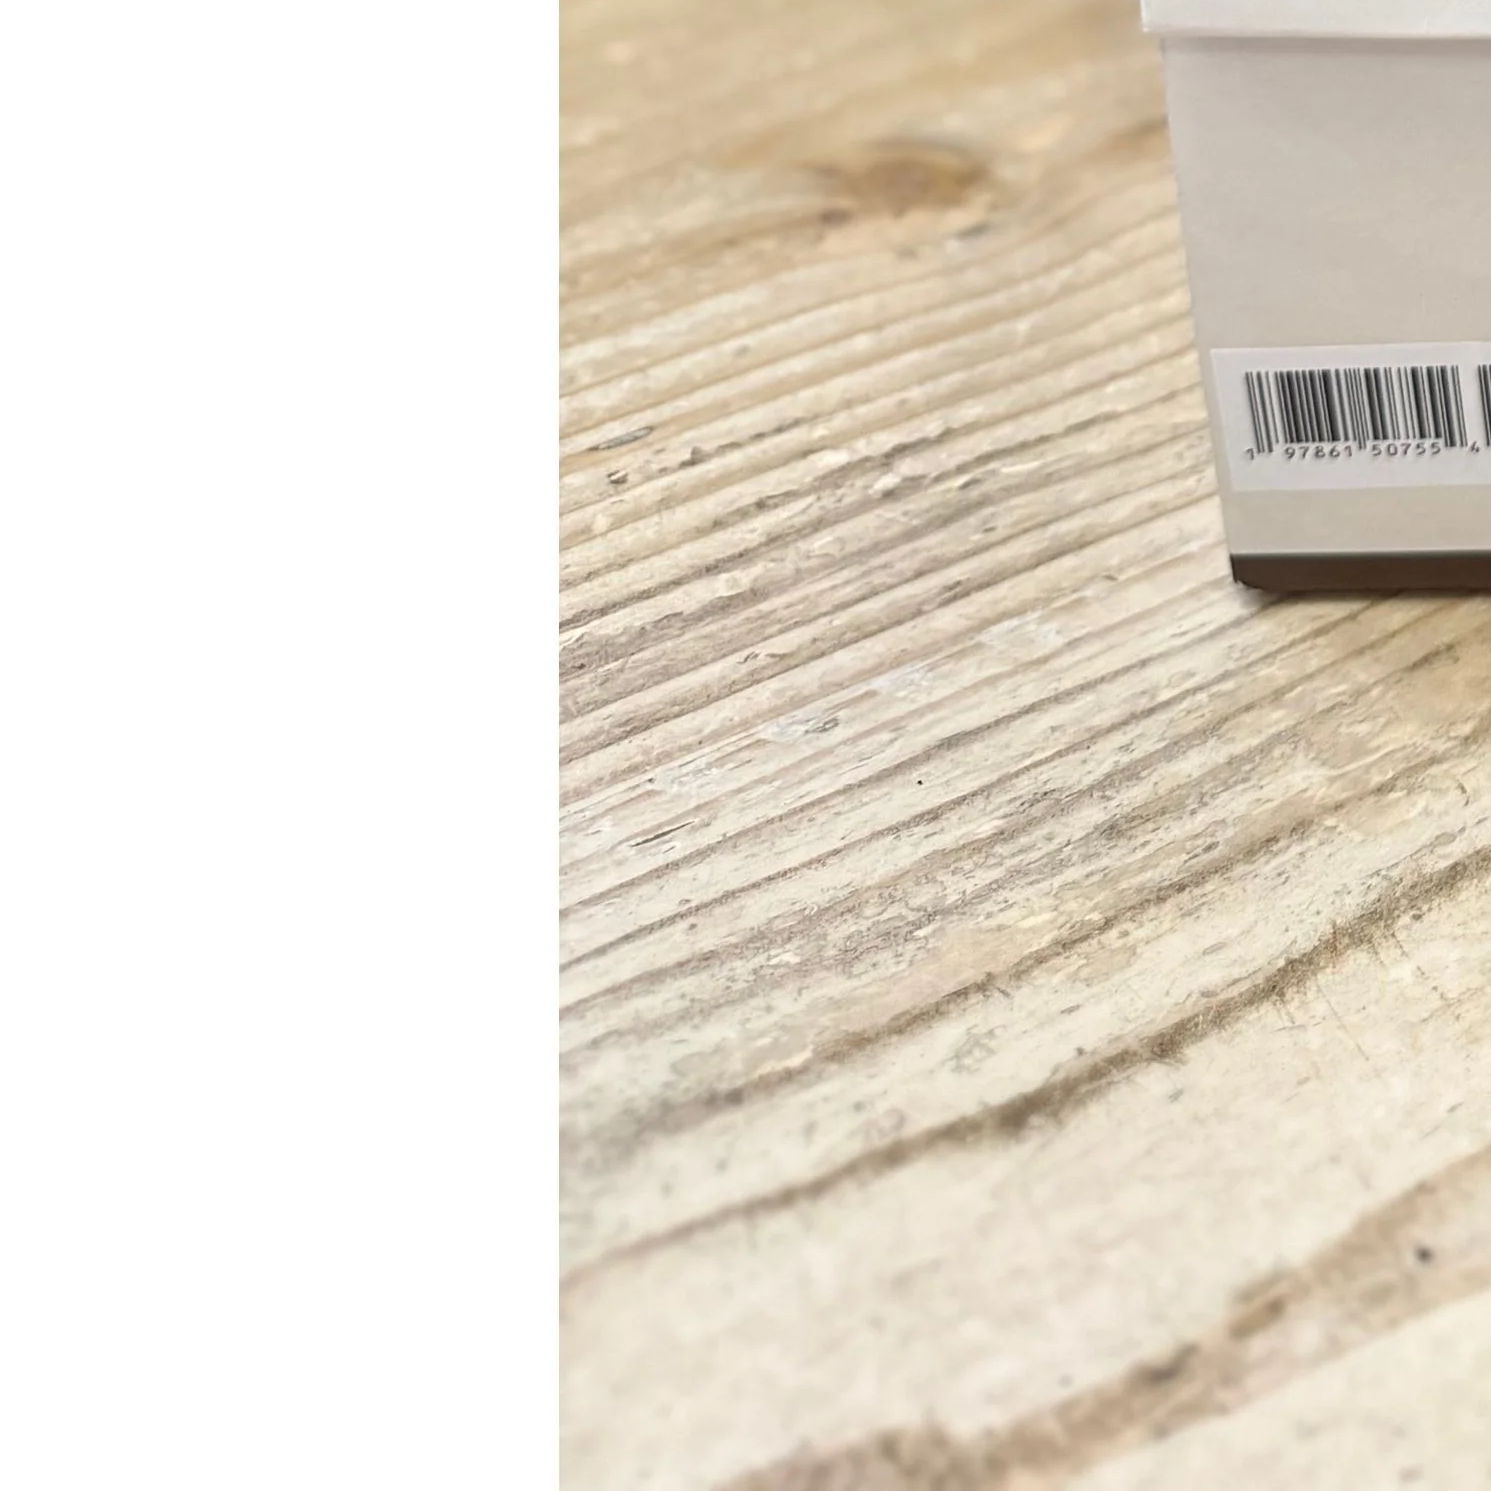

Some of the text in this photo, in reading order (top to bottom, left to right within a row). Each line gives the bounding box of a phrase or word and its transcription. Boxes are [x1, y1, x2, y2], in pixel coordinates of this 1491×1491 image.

[1245, 447, 1256, 461] 1
[1284, 444, 1353, 460] 97861
[1371, 441, 1442, 457] 50755
[1468, 440, 1481, 454] 4
